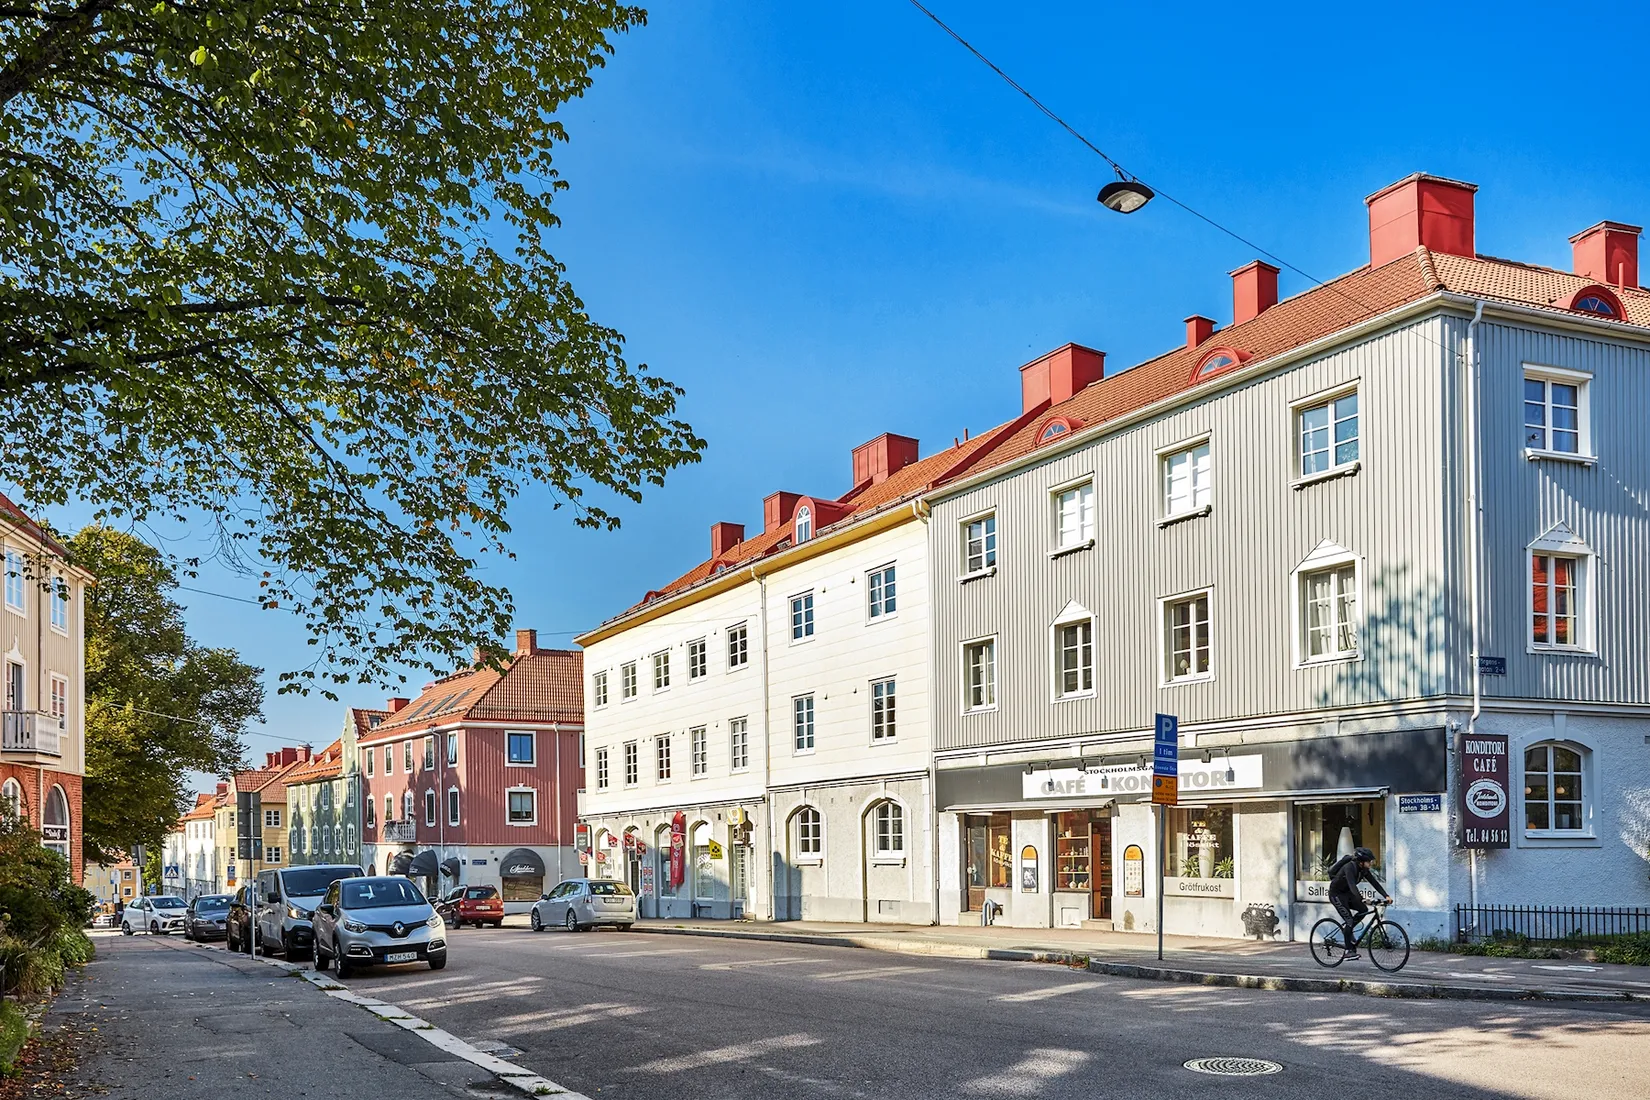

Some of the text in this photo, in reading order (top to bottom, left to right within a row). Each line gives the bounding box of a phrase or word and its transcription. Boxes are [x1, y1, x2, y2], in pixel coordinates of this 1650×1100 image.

[1161, 717, 1173, 740] P
[1163, 748, 1174, 756] tim
[1465, 740, 1506, 755] KONDITORI
[1084, 764, 1153, 775] STOCKHOLMSGA
[1473, 755, 1497, 773] CAFÉ
[1041, 775, 1086, 796] CAFÉ
[1465, 828, 1480, 843] Tel.
[1491, 829, 1499, 843] 56
[1179, 881, 1222, 893] Grötfrukost
[1308, 886, 1330, 897] Salla
